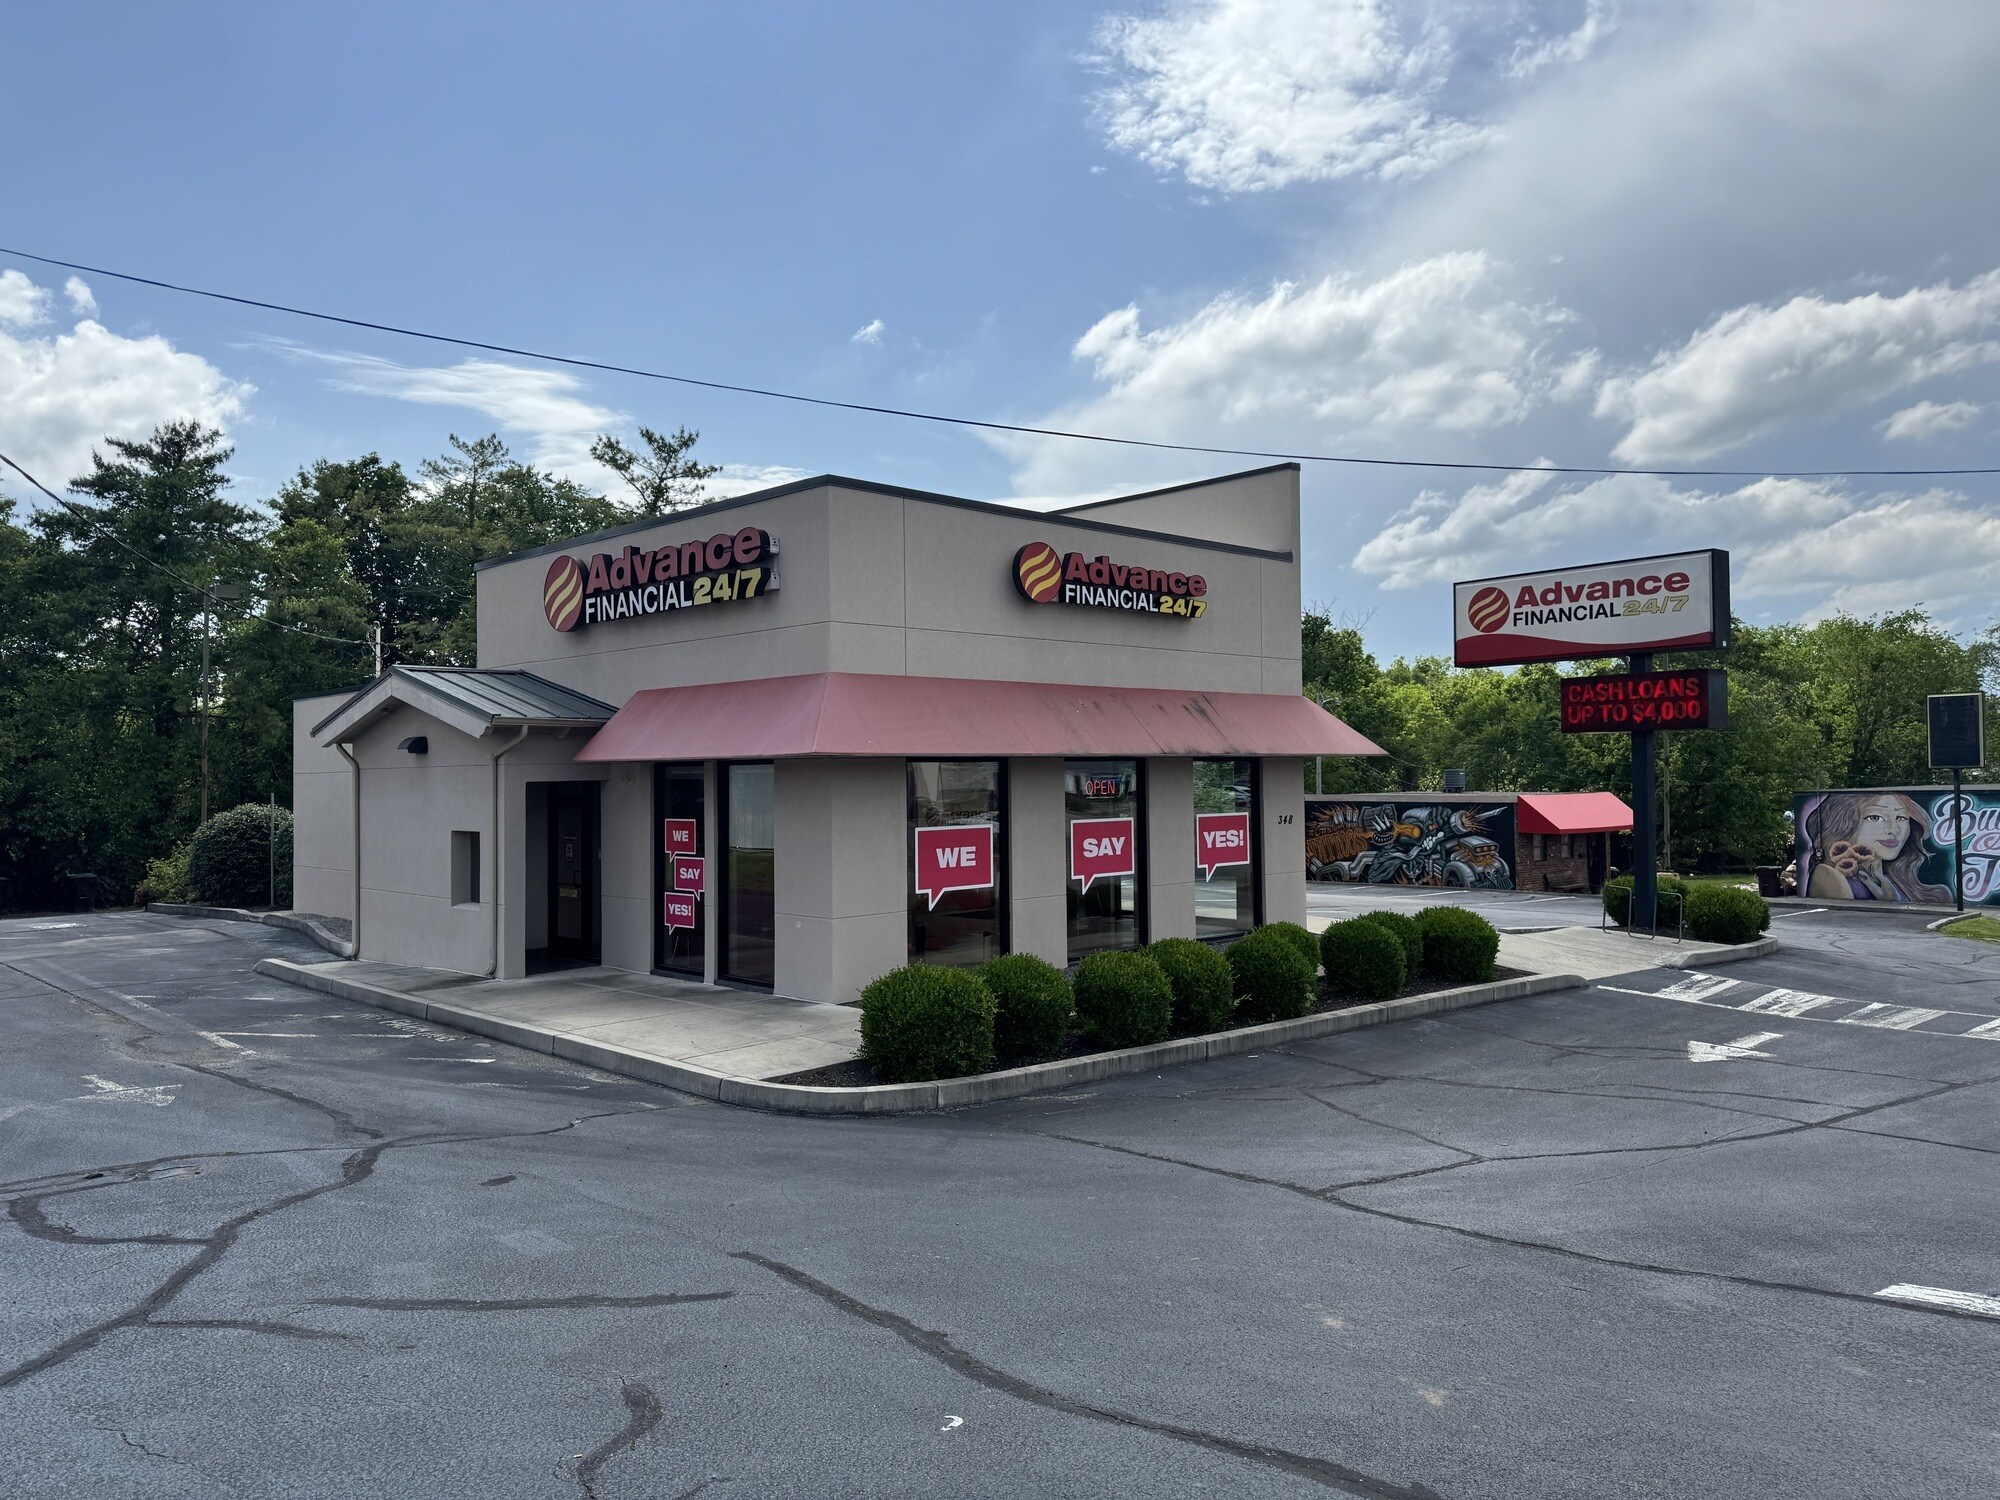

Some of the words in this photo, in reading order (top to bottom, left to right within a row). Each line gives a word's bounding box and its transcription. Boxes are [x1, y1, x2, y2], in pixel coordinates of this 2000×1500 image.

[585, 527, 764, 594] Advance
[1065, 552, 1208, 598] Advance
[585, 580, 693, 624] FINANCIAL
[692, 567, 763, 606] 24/7
[1065, 583, 1159, 613] FINANCIAL
[1159, 595, 1208, 618] 24/7
[1514, 571, 1690, 609] Advance
[1513, 602, 1622, 627] FINANCIAL
[1622, 595, 1689, 617] 24/7
[1568, 682, 1624, 703] CASH
[1628, 677, 1700, 700] LOANS
[1567, 706, 1595, 724] UP
[1599, 703, 1628, 722] TO
[1632, 700, 1701, 724] $4,000
[1085, 780, 1116, 796] OPEN
[1278, 814, 1294, 825] 348
[672, 830, 689, 842] WE
[1083, 836, 1126, 858] SAY
[1202, 829, 1244, 849] YES!
[935, 846, 976, 869] WE
[679, 867, 701, 880] SAY
[668, 903, 692, 917] YES!
